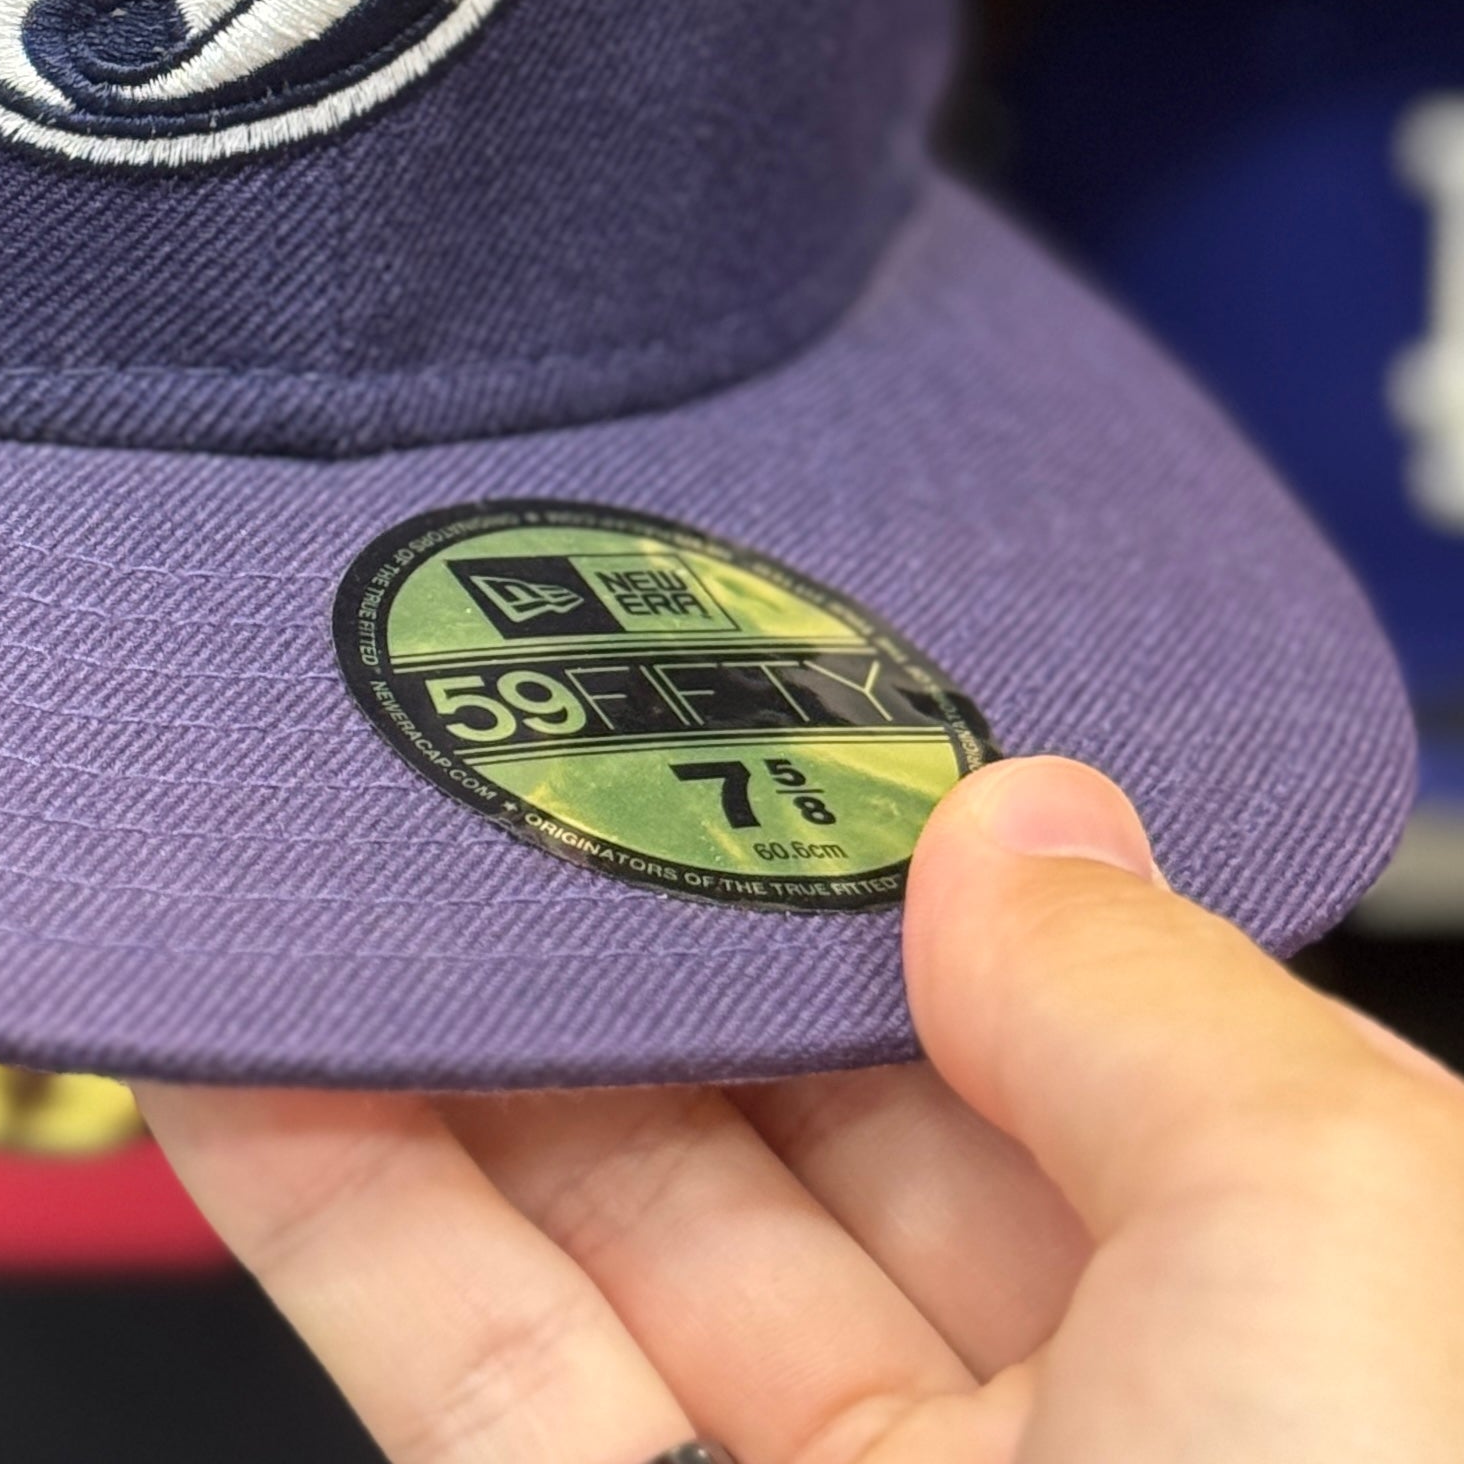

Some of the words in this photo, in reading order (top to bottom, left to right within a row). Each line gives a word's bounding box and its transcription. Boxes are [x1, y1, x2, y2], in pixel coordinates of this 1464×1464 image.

[393, 548, 415, 566] OF
[371, 563, 400, 587] THE
[594, 570, 688, 594] NEW
[358, 586, 385, 620] TRUE
[614, 593, 709, 617] ERA
[425, 659, 894, 742] 59FIFTY
[369, 680, 498, 800] NEWERACAP.COM
[668, 760, 761, 829] 7
[524, 812, 678, 881] ORIGINATORS
[684, 872, 715, 888] OF
[719, 877, 768, 895] THE
[769, 882, 830, 897] TRUE
[752, 840, 849, 861] 60.6cm
